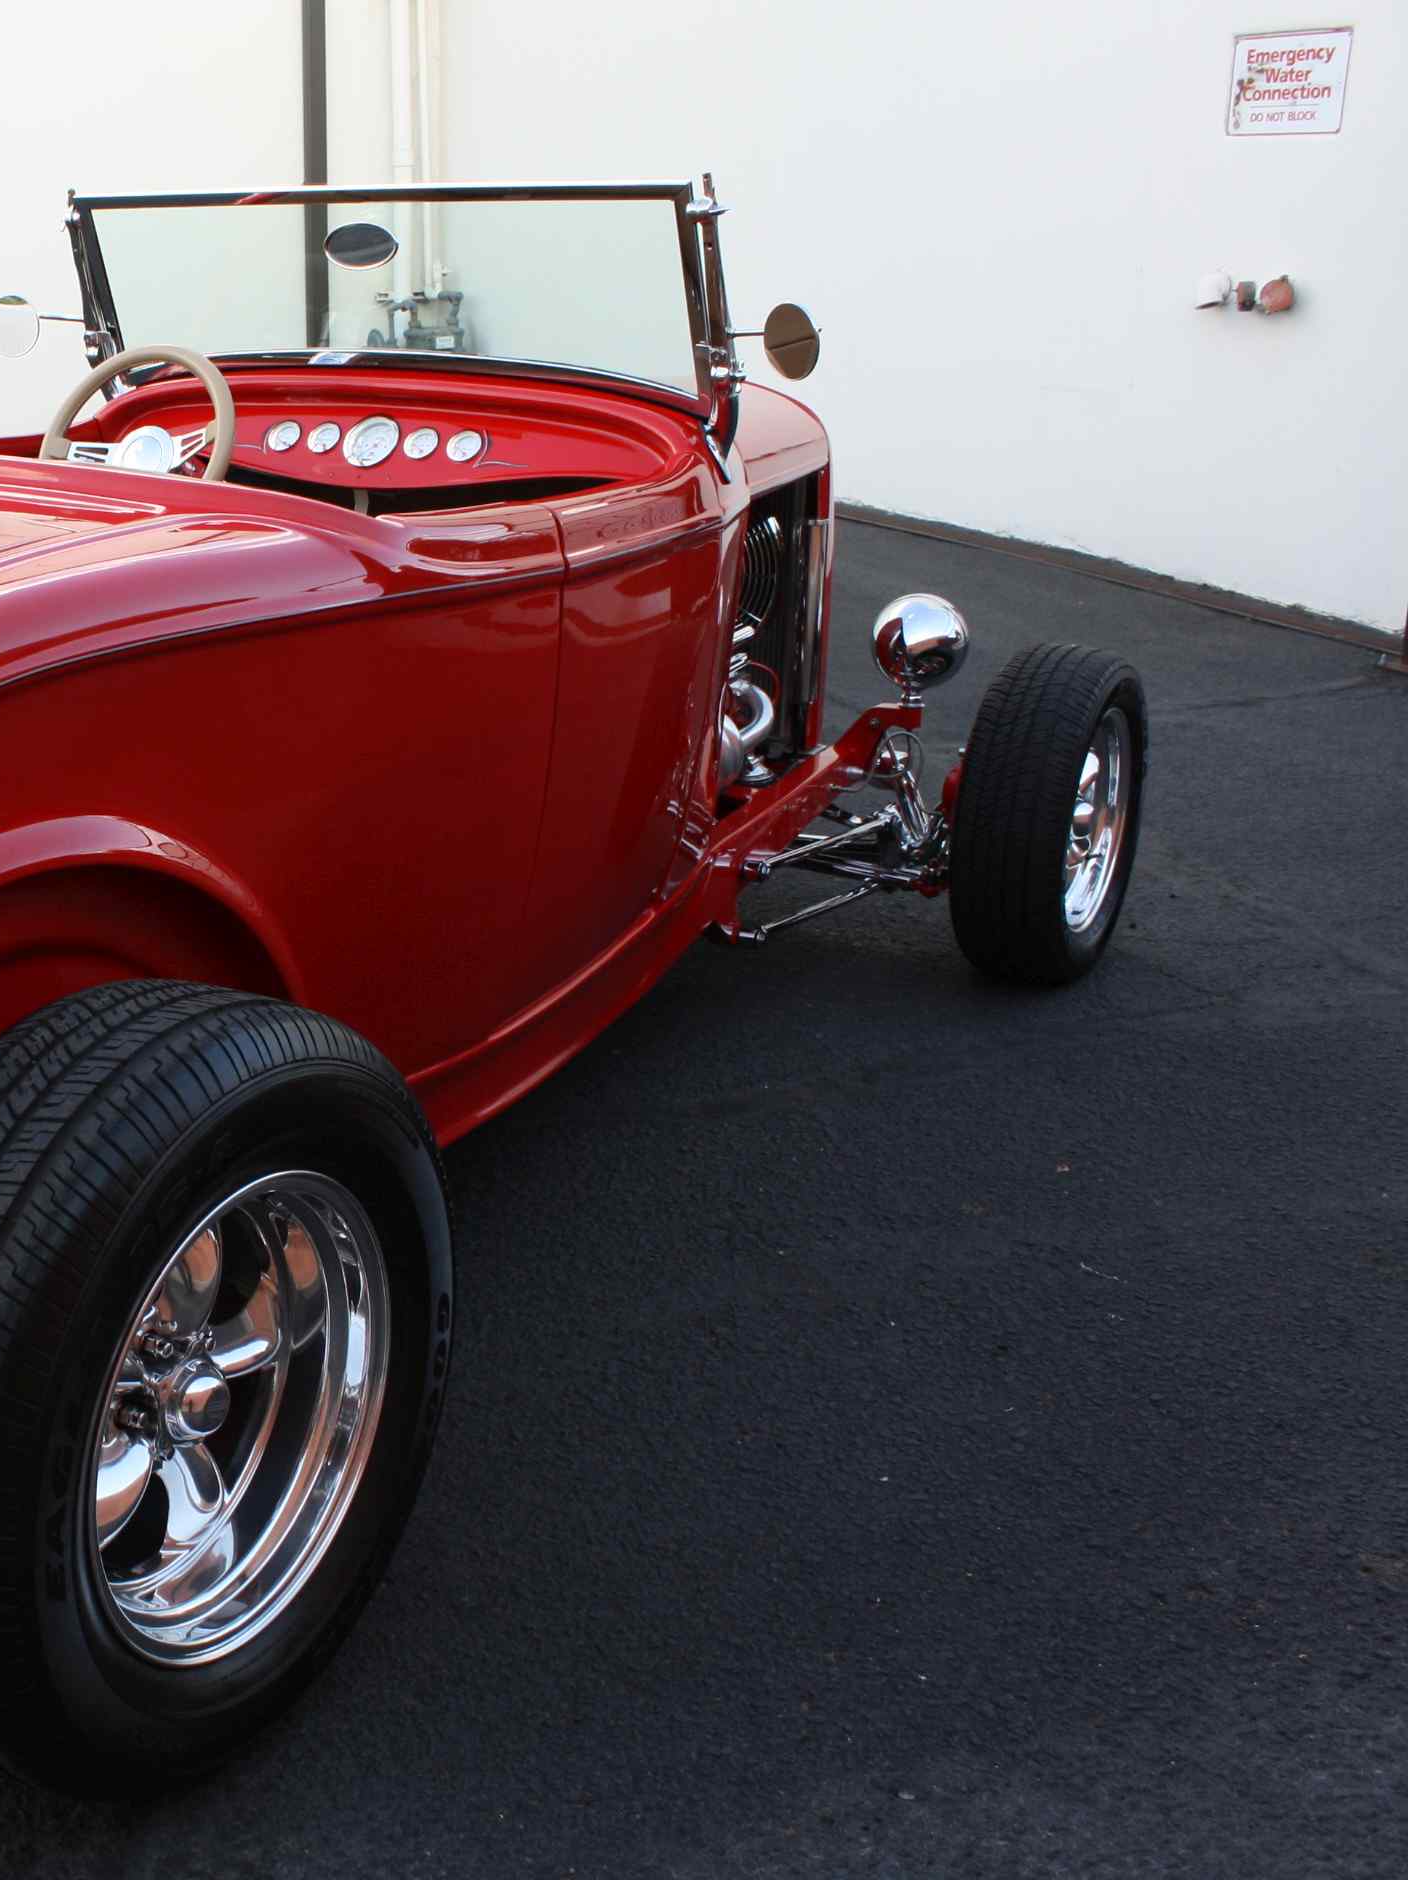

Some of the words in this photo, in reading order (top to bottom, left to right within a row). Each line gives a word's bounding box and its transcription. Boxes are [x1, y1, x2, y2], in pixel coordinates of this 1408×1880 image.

[1247, 47, 1336, 66] Emergency
[1264, 67, 1312, 83] Water
[1243, 84, 1332, 102] Connection
[1250, 112, 1263, 122] DO
[1266, 111, 1285, 122] NOT
[1288, 110, 1317, 121] BLOCK
